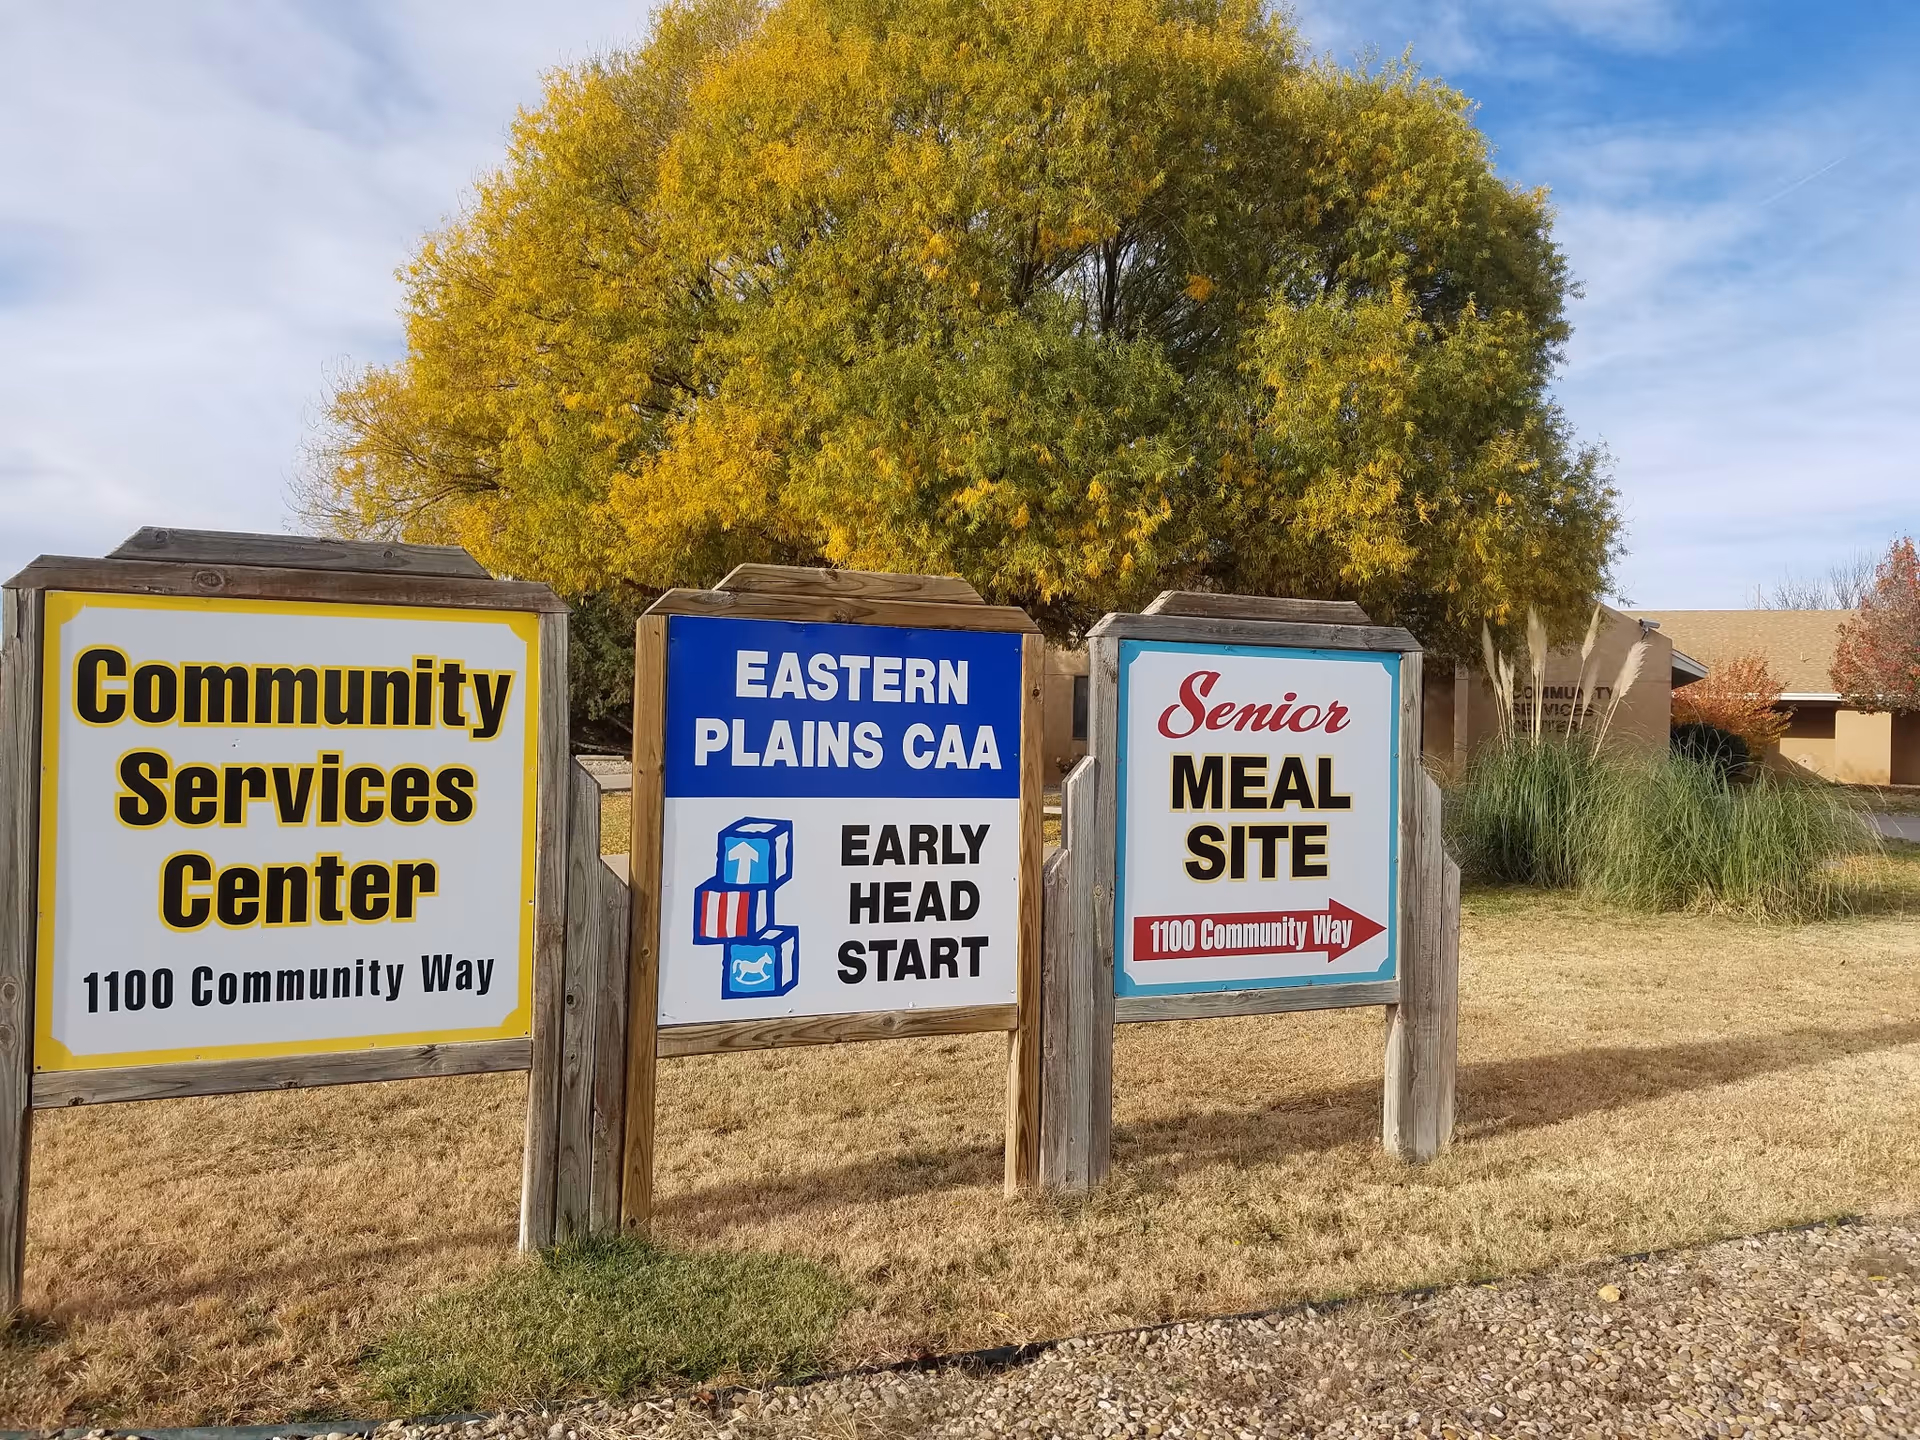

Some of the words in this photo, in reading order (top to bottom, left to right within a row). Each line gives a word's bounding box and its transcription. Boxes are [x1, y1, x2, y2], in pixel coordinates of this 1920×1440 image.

[75, 647, 513, 740] Community
[735, 650, 969, 705] EASTERN
[1157, 670, 1351, 739] Senior
[1512, 686, 1614, 700] COMMUNTY
[694, 717, 884, 769] PLAINS
[902, 723, 1002, 770] CAA
[117, 750, 476, 828] Services
[1171, 754, 1351, 811] MEAL
[840, 824, 991, 867] EARLY
[1184, 823, 1329, 881] SITE
[160, 852, 438, 929] Center
[848, 880, 981, 925] HEAD
[837, 936, 989, 984] START
[1149, 920, 1196, 952] 1100
[1199, 917, 1308, 951] Community
[1312, 914, 1353, 949] Way
[83, 968, 175, 1014] 1100
[190, 958, 405, 1007] Community
[420, 953, 496, 996] Way
